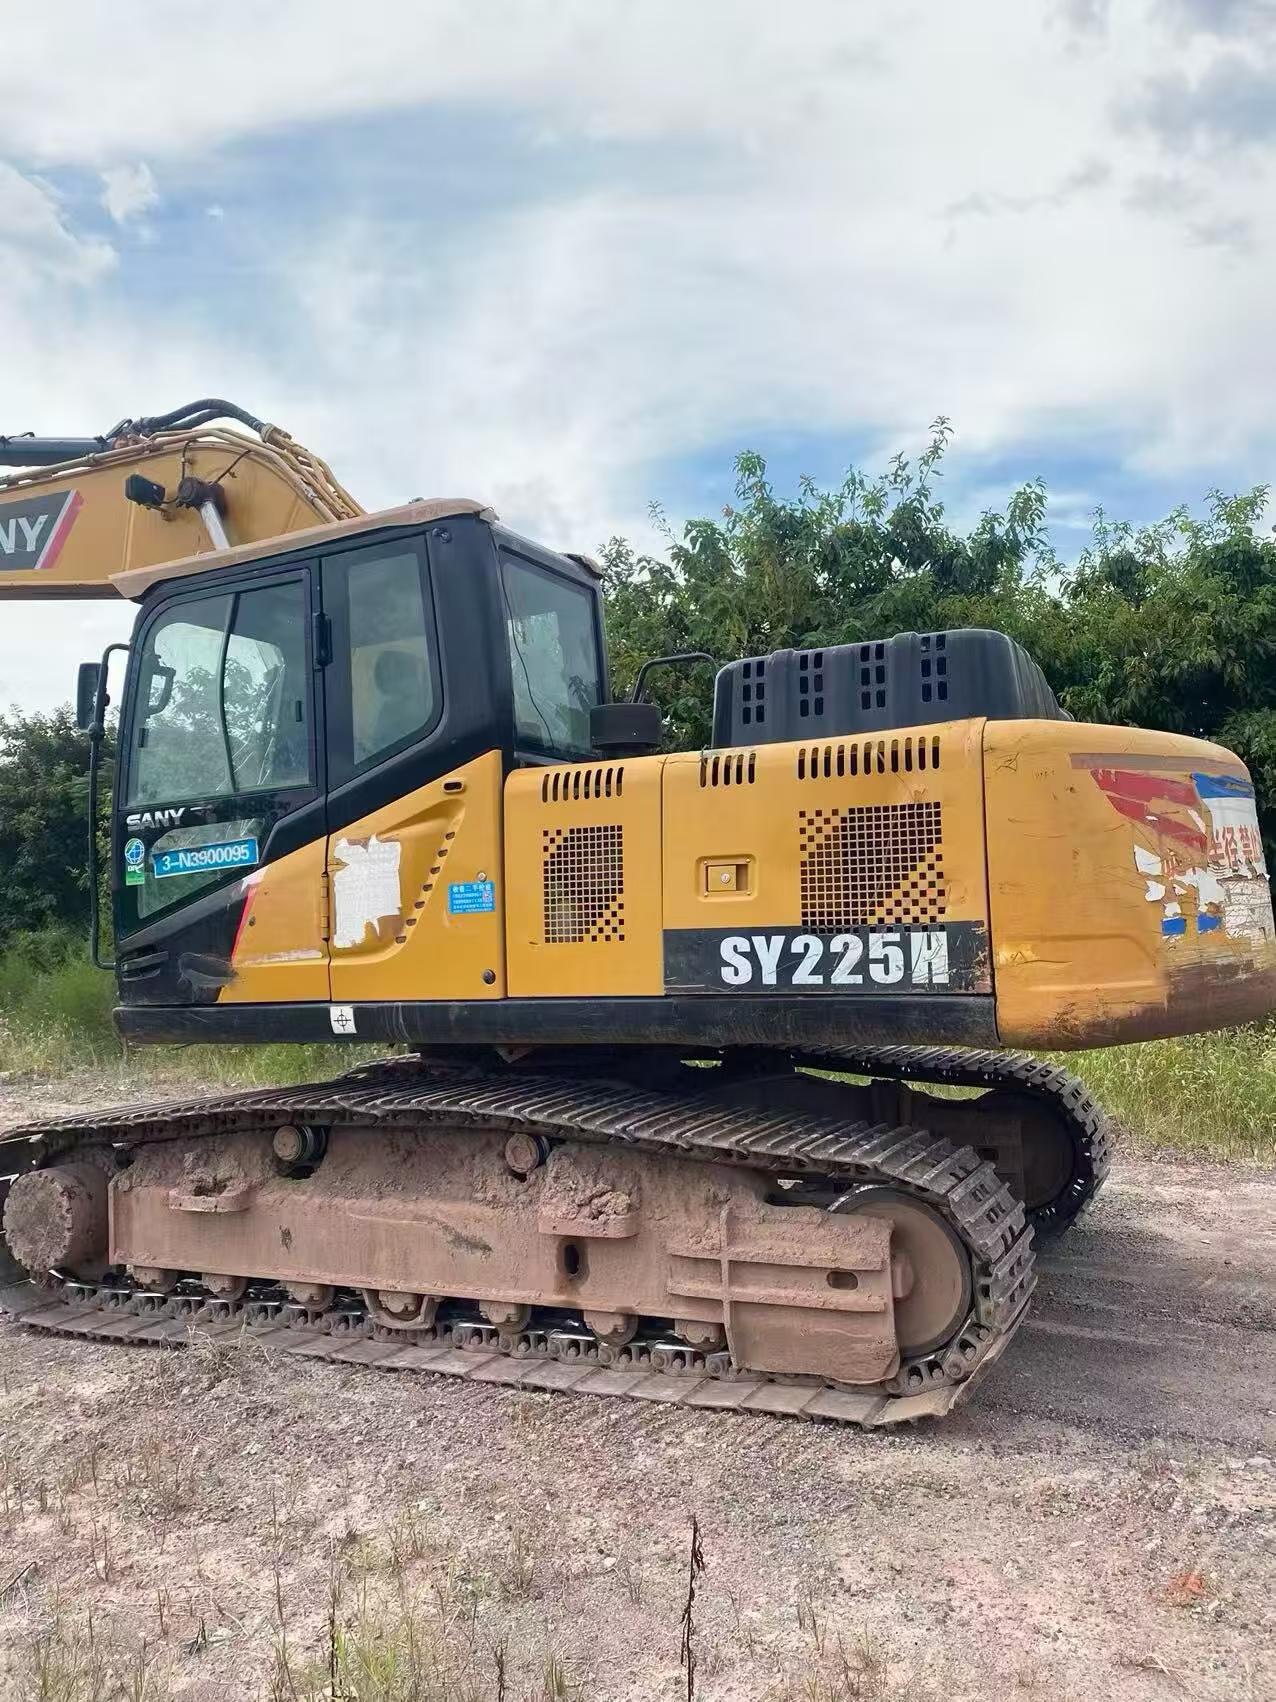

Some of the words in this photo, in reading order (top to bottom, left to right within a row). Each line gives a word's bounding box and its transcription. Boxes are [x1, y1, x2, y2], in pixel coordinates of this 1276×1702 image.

[126, 807, 186, 832] SANY
[162, 844, 250, 871] 3-N3900095
[720, 931, 949, 985] SY225H
